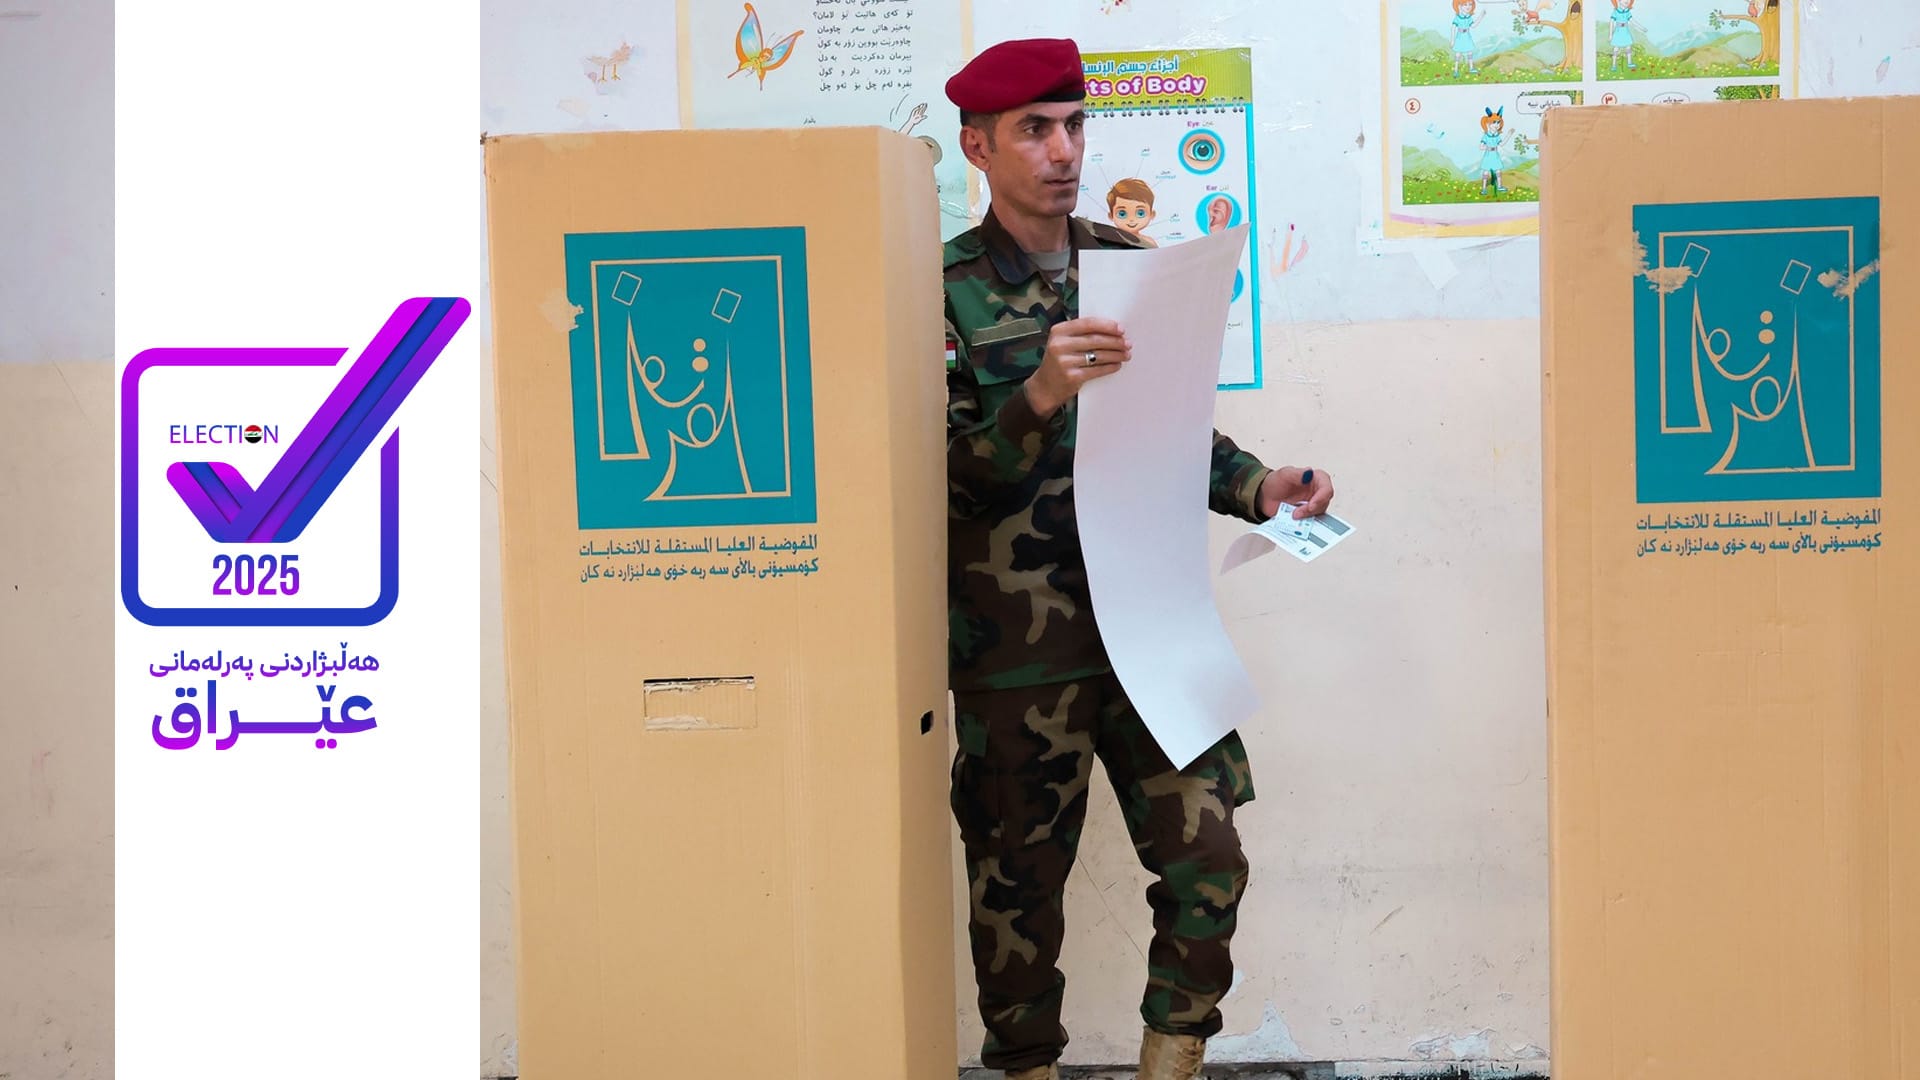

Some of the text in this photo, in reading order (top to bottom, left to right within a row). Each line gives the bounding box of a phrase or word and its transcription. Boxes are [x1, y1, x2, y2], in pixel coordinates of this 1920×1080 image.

[1082, 61, 1115, 77] الإنسا
[1116, 61, 1147, 75] جسم
[1116, 76, 1143, 95] of
[1146, 74, 1206, 96] Body
[1637, 508, 1880, 533] المفوضية العليا المستقلة للانتخابات
[580, 534, 817, 559] المفوضية العليا المستقلة للانتخابات
